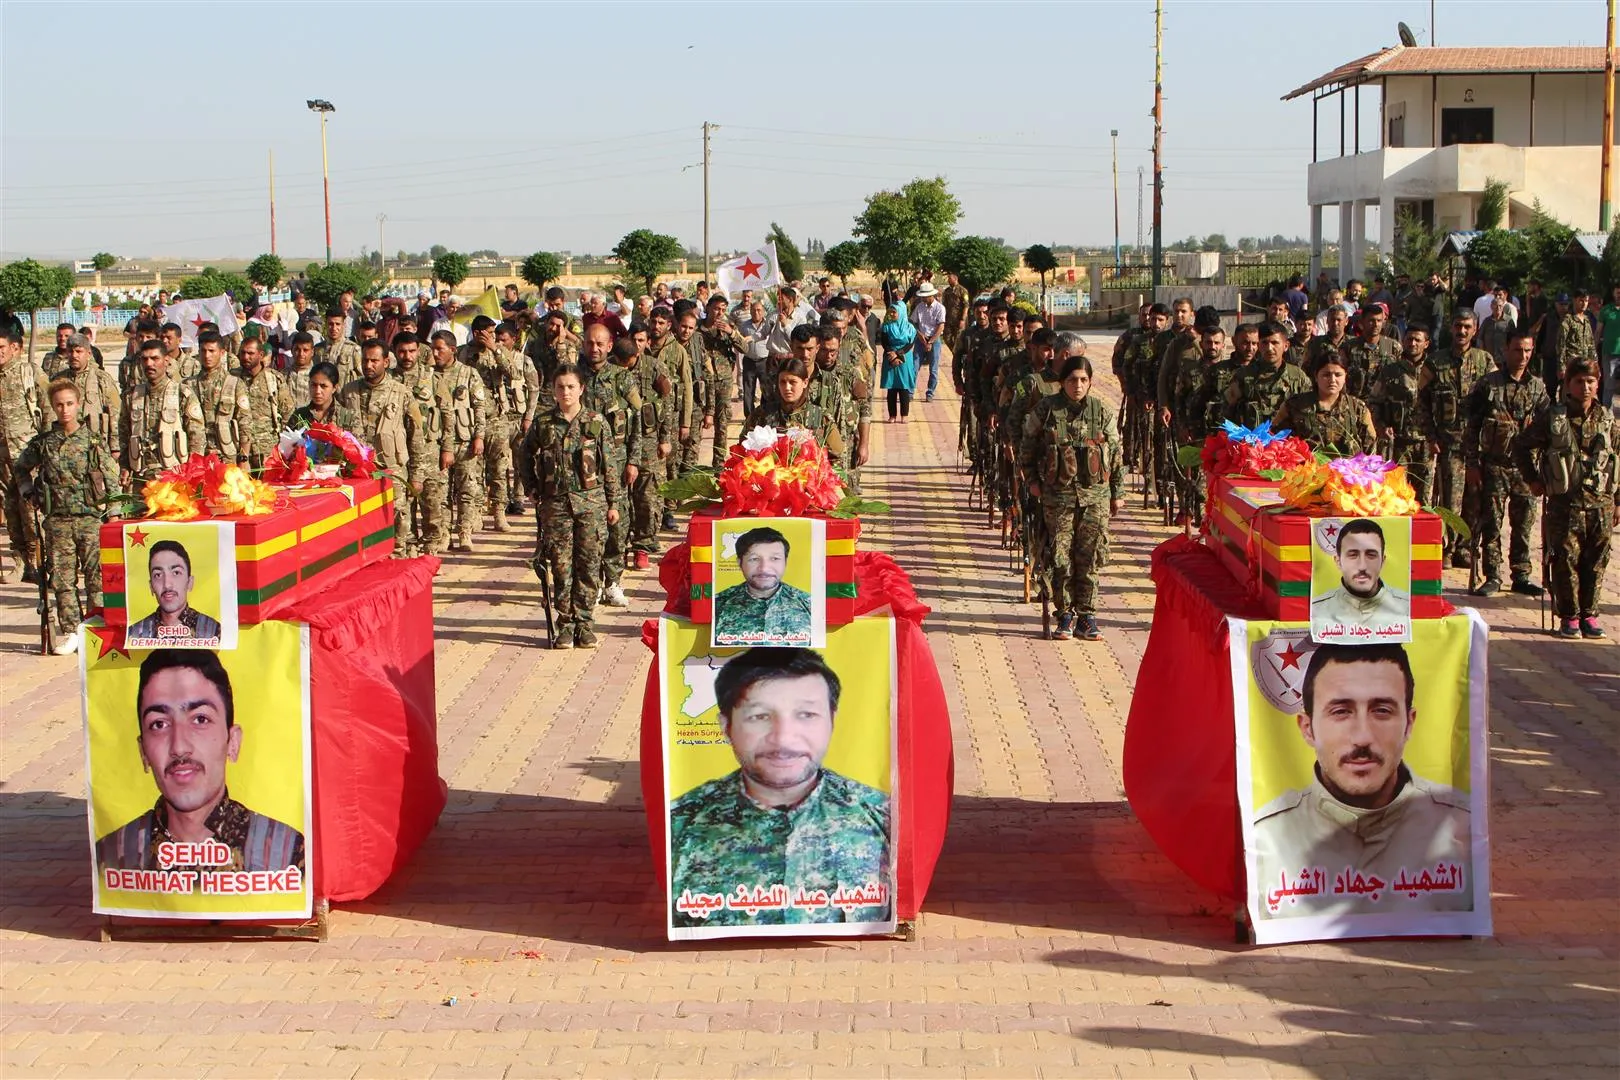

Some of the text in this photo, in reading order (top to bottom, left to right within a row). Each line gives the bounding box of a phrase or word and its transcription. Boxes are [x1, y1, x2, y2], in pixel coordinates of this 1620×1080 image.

[131, 636, 218, 647] DEMHAT HESEKÊ
[1318, 623, 1406, 640] الشهيد جهاد الشبلي
[160, 840, 229, 866] ŞEHÎD
[106, 868, 300, 892] DEMHAT HESEKÊ
[1268, 862, 1464, 910] الشهيد جهاد الشبلي
[679, 883, 888, 915] الشهيد عبد اللطيف مجيد
